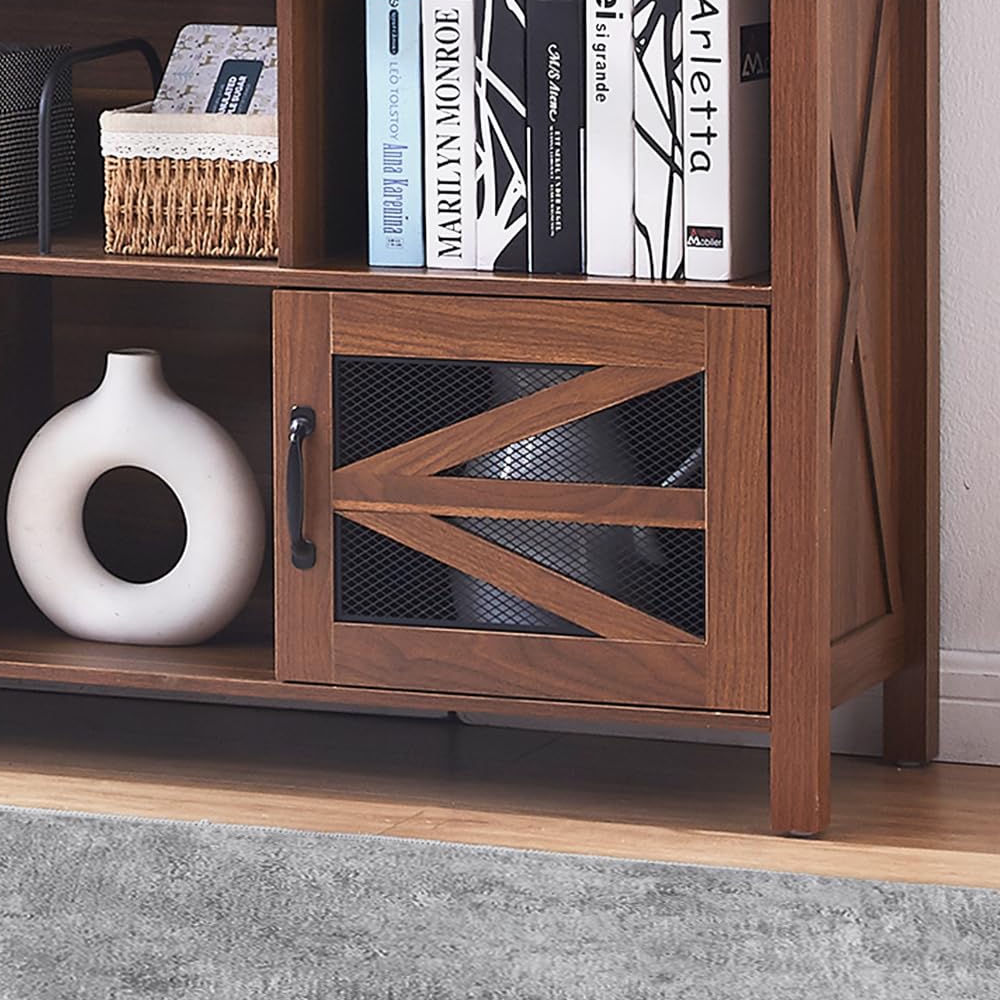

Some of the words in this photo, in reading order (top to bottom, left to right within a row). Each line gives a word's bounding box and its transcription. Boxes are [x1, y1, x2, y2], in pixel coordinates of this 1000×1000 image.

[434, 8, 460, 126] MONROE
[592, 42, 610, 103] grande
[389, 88, 399, 141] TOLSTOY
[382, 143, 408, 173] Anna
[382, 179, 409, 234] Karenina
[437, 133, 462, 258] MARILYN
